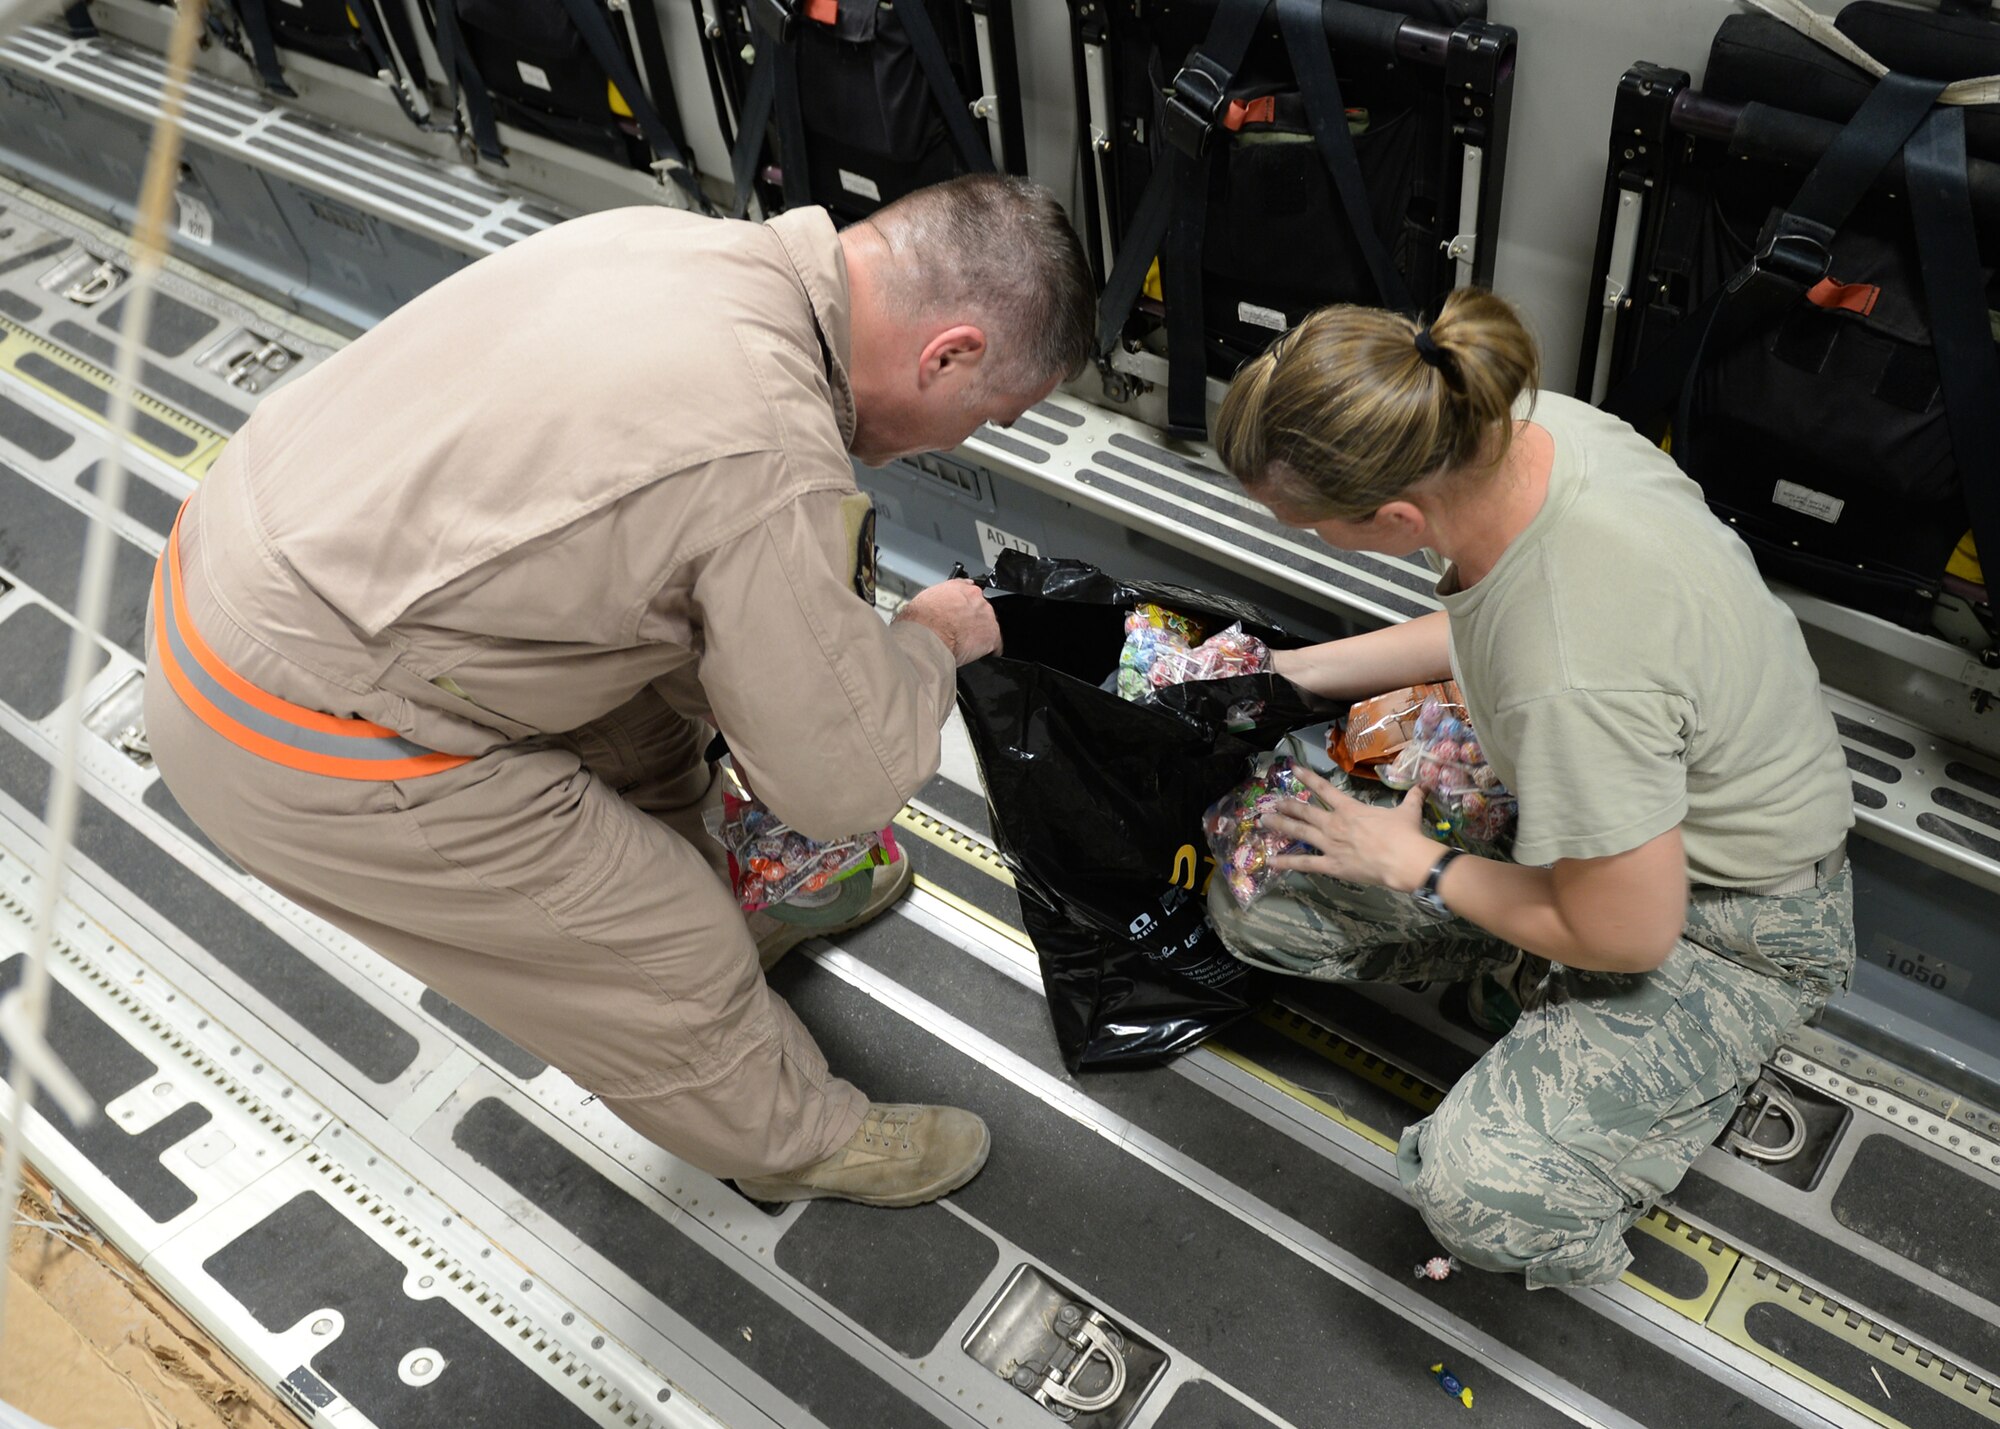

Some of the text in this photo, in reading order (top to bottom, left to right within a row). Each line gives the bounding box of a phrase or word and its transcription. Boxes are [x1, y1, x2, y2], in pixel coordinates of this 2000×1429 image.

[987, 527, 1030, 555] AD 17
[1886, 953, 1948, 990] 1050
